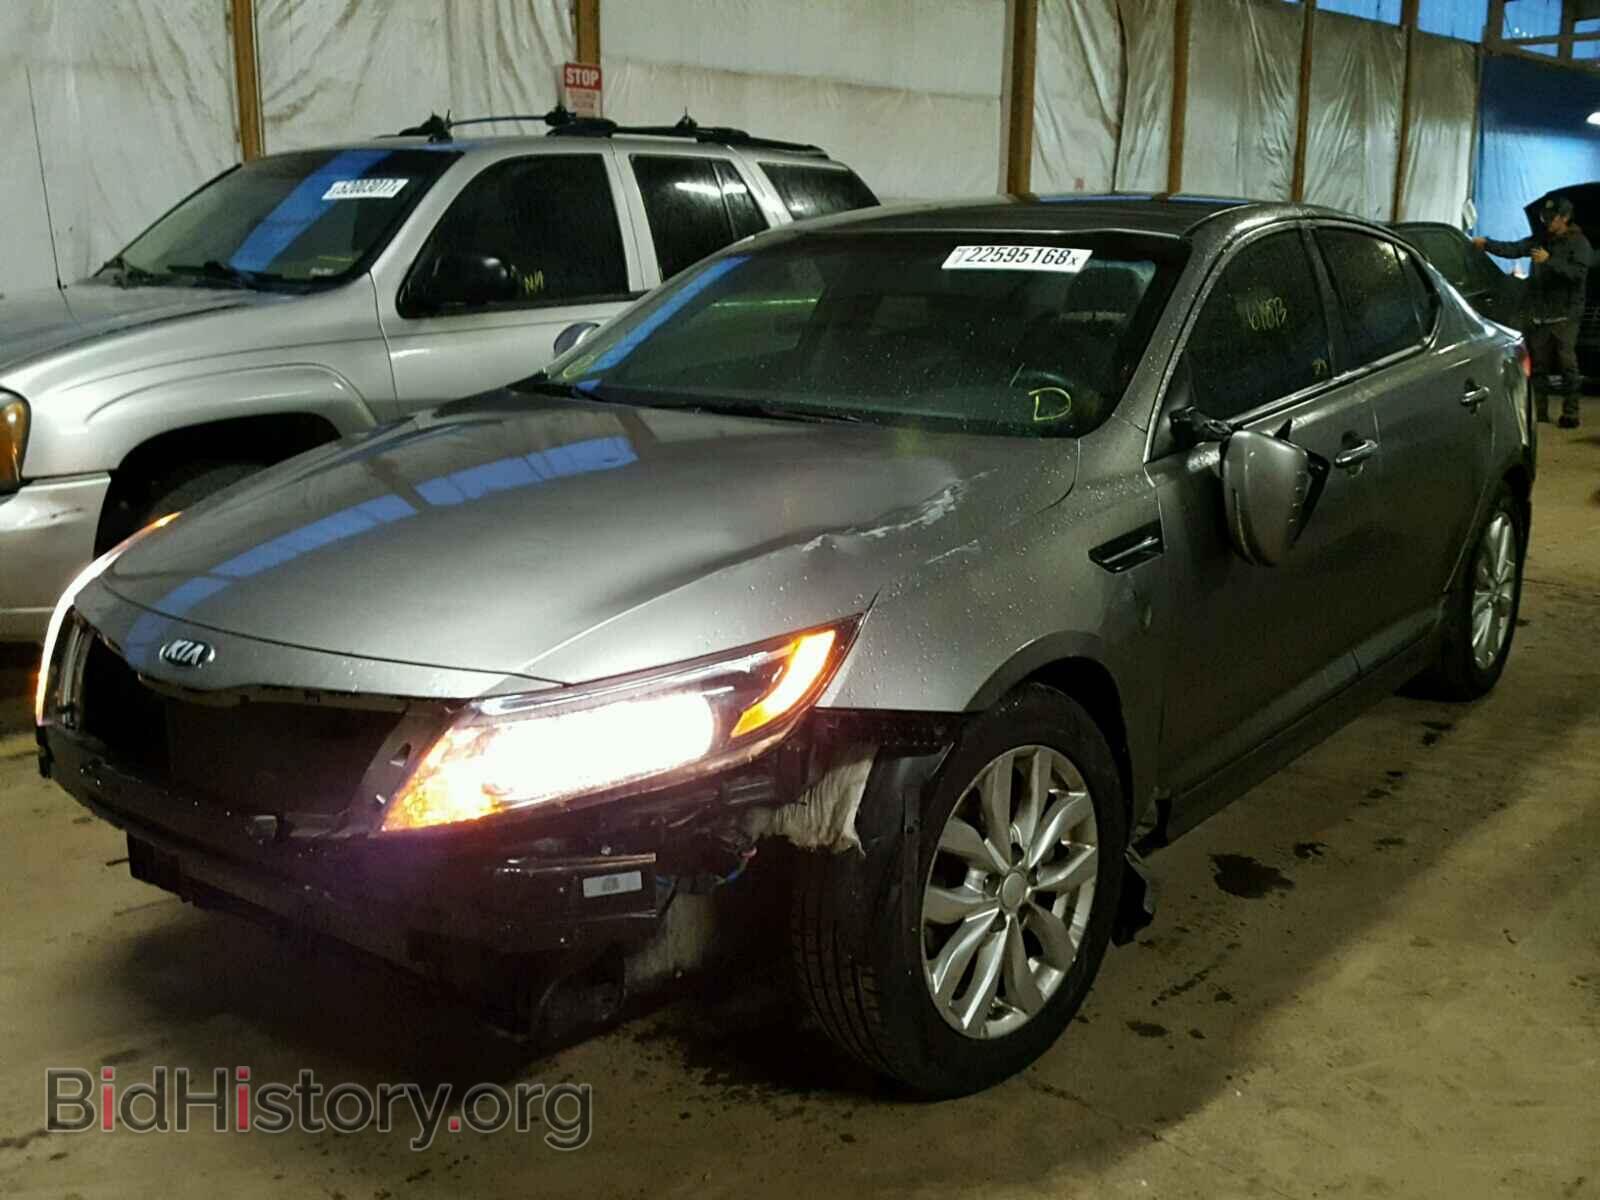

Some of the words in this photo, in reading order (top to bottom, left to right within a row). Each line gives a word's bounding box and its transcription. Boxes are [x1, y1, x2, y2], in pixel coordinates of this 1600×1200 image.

[566, 67, 600, 86] STOP
[1028, 386, 1072, 421] D
[165, 639, 205, 665] KIA
